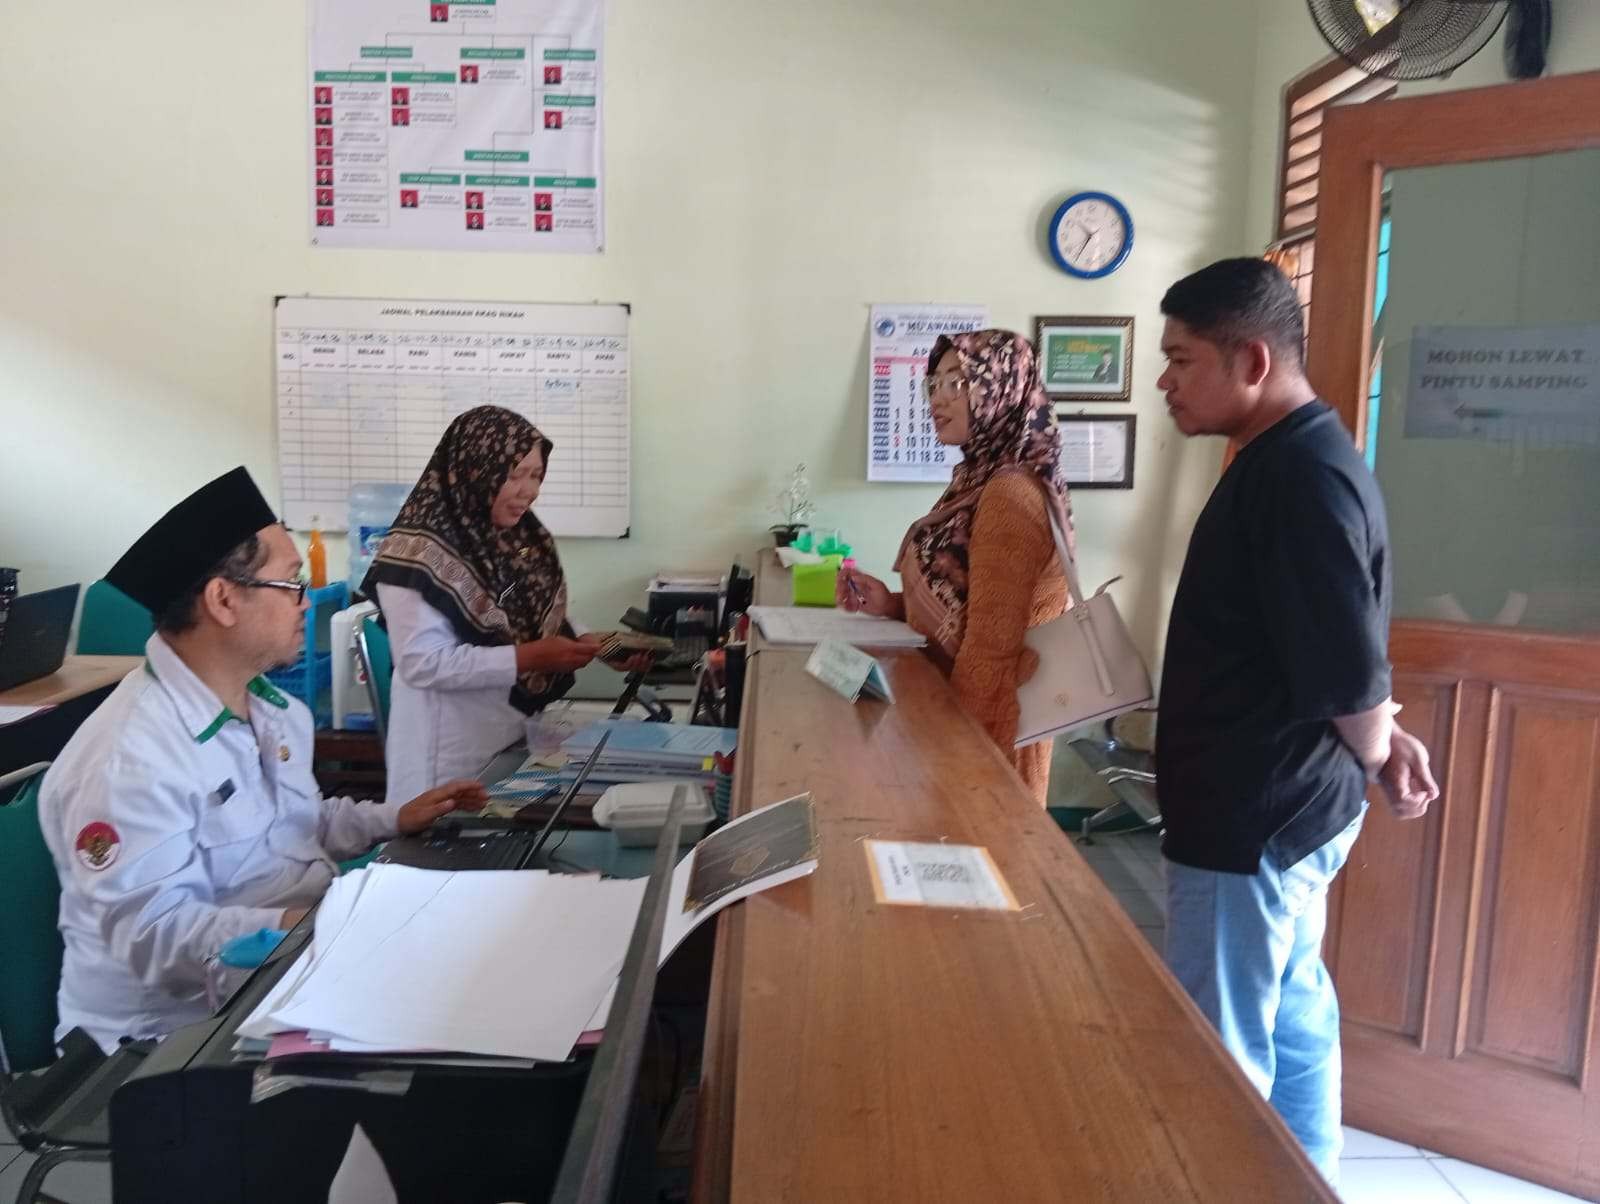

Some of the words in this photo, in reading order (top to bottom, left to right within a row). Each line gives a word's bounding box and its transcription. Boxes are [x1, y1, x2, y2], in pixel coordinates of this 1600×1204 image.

[1427, 350, 1503, 364] MOHON
[1509, 349, 1586, 364] LEWAT
[909, 379, 915, 391] 6
[1420, 375, 1484, 389] PINTU
[1489, 375, 1588, 390] SAMPING
[909, 393, 915, 405] 7
[894, 422, 900, 433] 2
[906, 436, 916, 448] 10
[920, 436, 930, 448] 17
[893, 450, 899, 461] 4
[906, 450, 916, 462] 11
[920, 450, 930, 462] 18
[934, 450, 945, 462] 25
